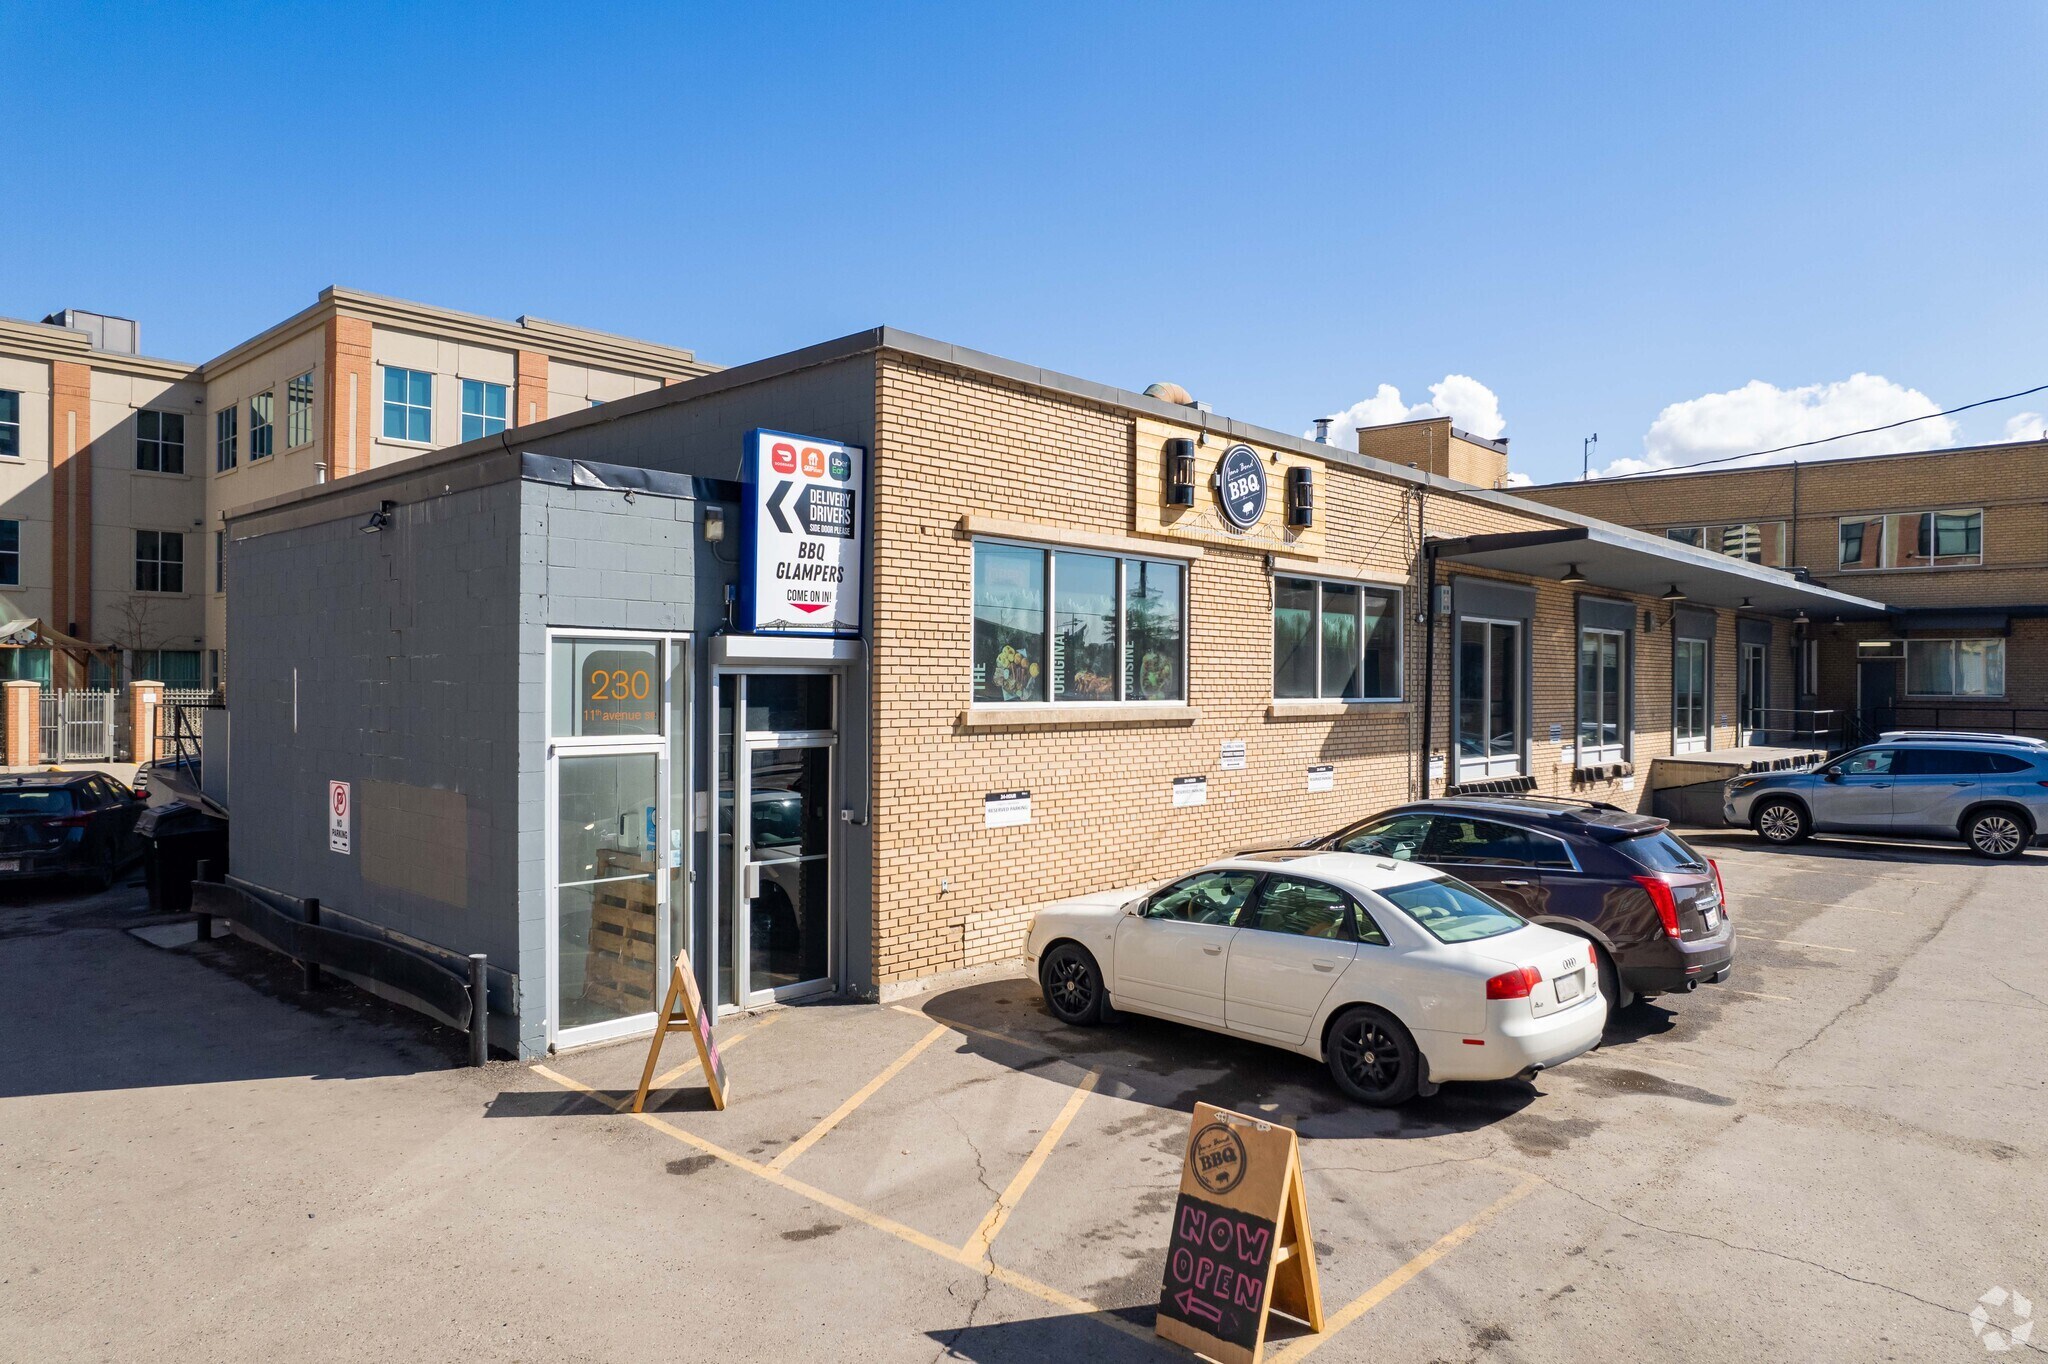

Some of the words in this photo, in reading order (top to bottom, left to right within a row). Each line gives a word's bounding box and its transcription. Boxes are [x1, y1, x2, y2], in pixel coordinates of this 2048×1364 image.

[832, 458, 848, 467] Uber
[1228, 473, 1260, 500] BBQ
[809, 489, 851, 507] DELIVERY
[809, 504, 851, 525] DRIVERS
[809, 523, 821, 532] SIDE
[821, 524, 834, 534] DOOR
[833, 526, 851, 536] PLEASE
[798, 541, 825, 562] BBQ
[776, 561, 844, 584] GLAMPERS
[786, 589, 809, 602] COME
[810, 590, 821, 602] ON
[822, 591, 832, 603] IN!
[973, 662, 986, 690] THE
[1125, 640, 1135, 694] CUISINE
[591, 669, 650, 700] 230
[584, 709, 602, 721] 11th
[602, 711, 642, 721] avenue
[332, 828, 347, 839] PARKING
[336, 819, 342, 827] NO
[1199, 1147, 1237, 1171] BBQ
[1179, 1205, 1270, 1266] NOW
[1172, 1247, 1263, 1312] OPEN
